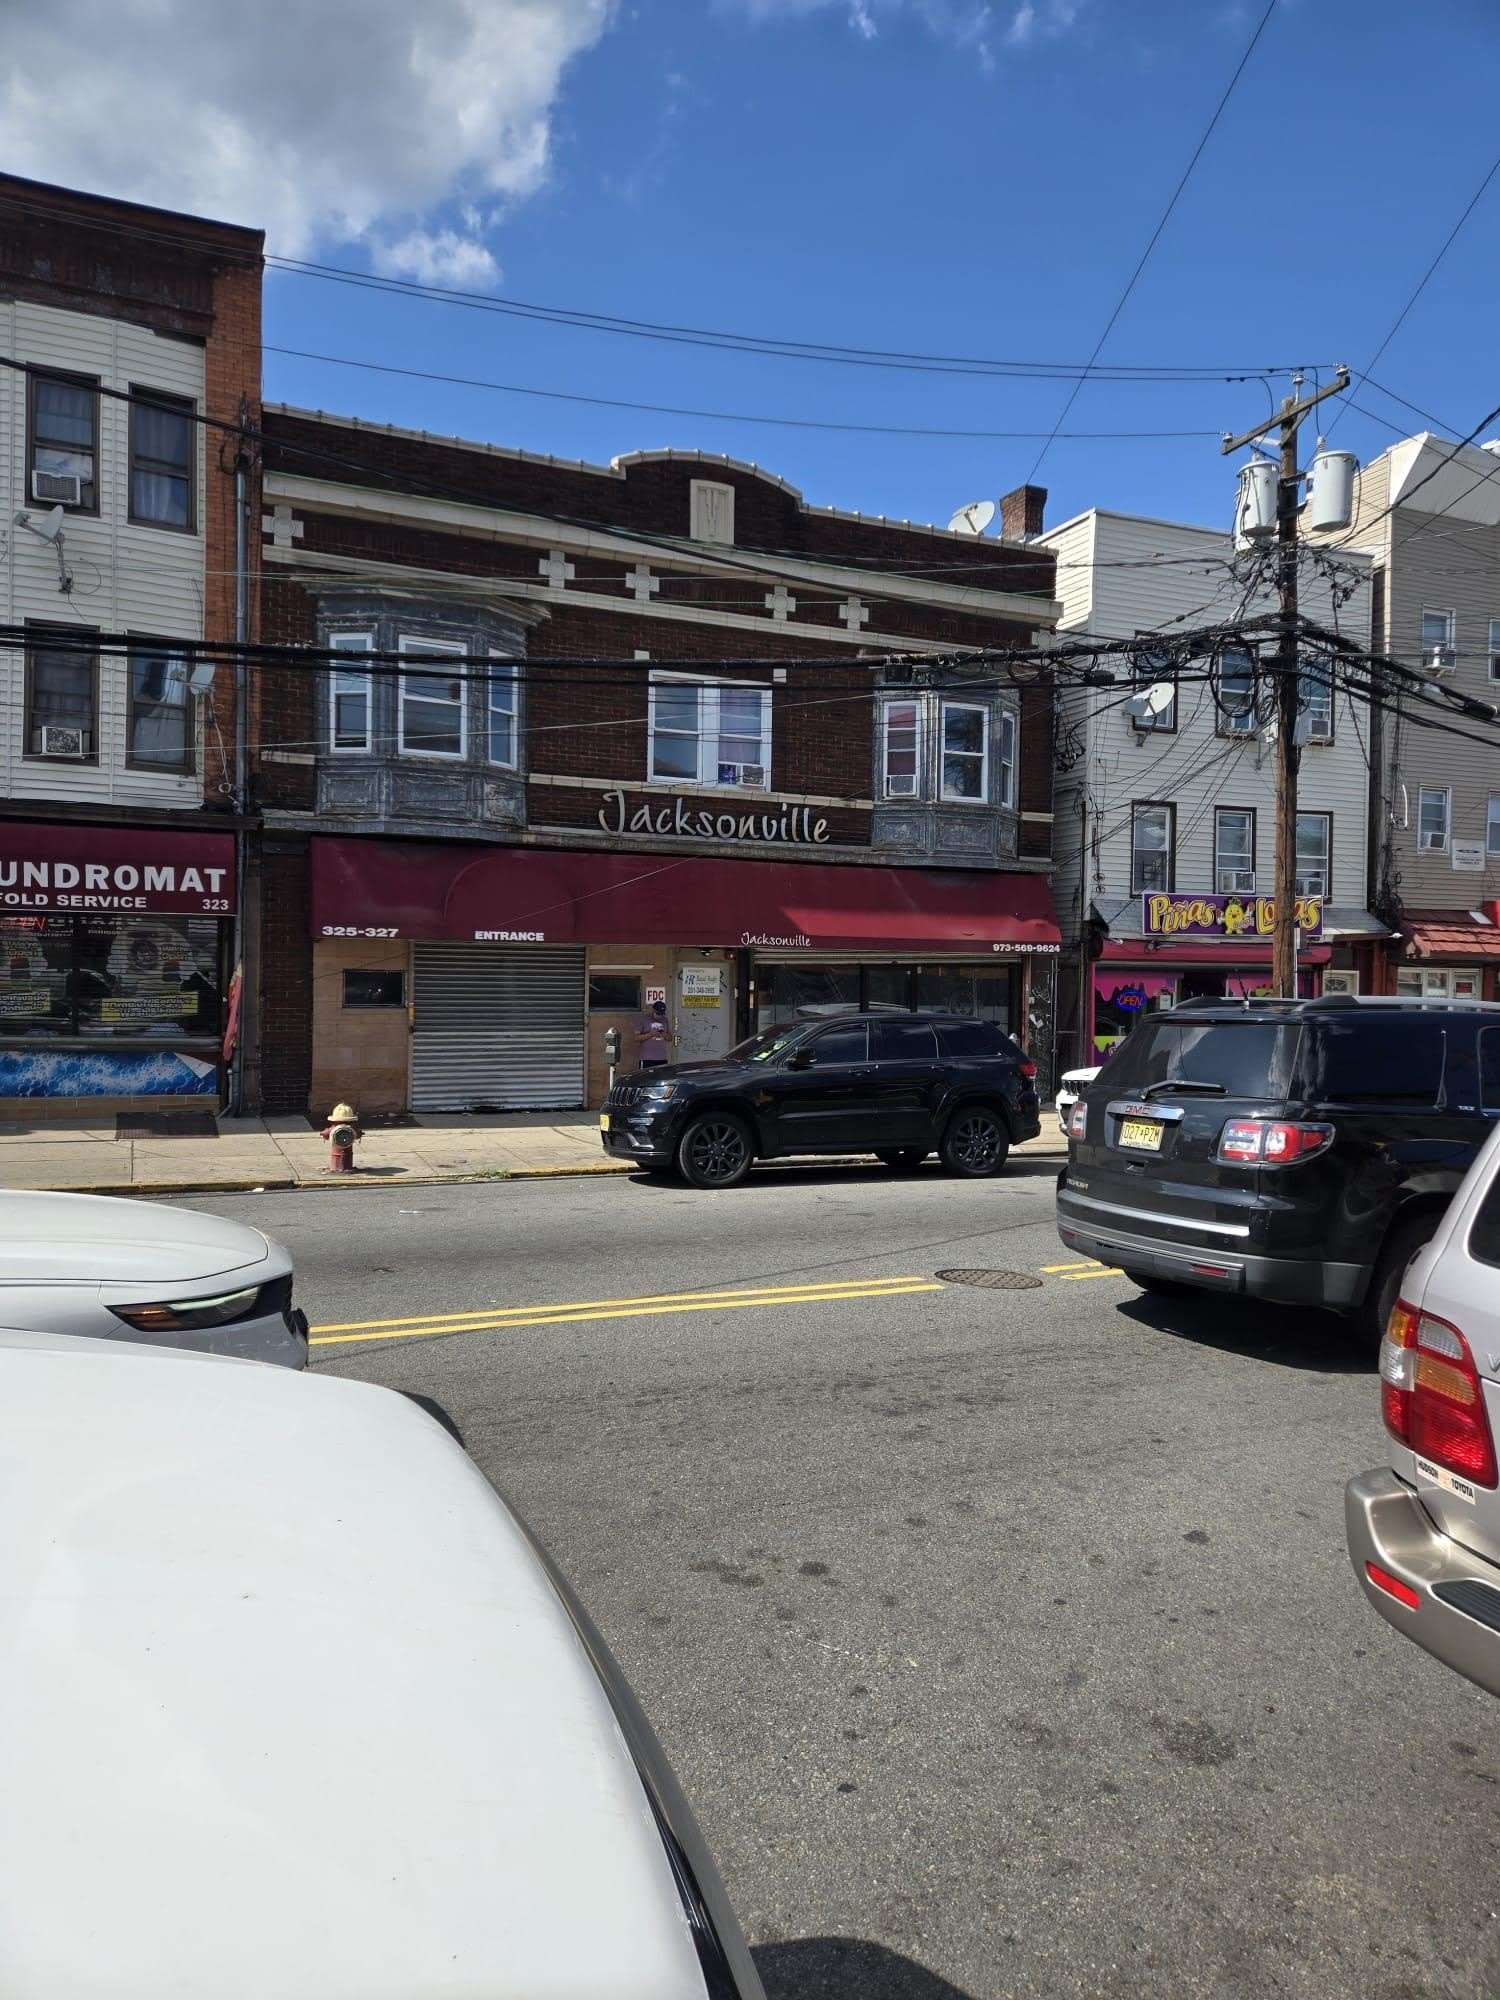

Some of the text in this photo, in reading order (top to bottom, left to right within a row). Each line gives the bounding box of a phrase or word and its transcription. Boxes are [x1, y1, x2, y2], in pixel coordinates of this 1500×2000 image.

[598, 789, 830, 844] Jacksonville
[56, 894, 148, 909] SERVICE
[202, 899, 230, 911] 323
[1149, 894, 1323, 935] Piñas Loas
[321, 925, 400, 939] 325-327
[474, 930, 545, 943] ENTRANCE
[740, 931, 812, 948] Jacksonville
[647, 990, 665, 1001] FDC
[1119, 995, 1143, 1008] OPEN
[1124, 1105, 1151, 1115] GMC
[1417, 1459, 1474, 1498] HUDSON TOYOTA
